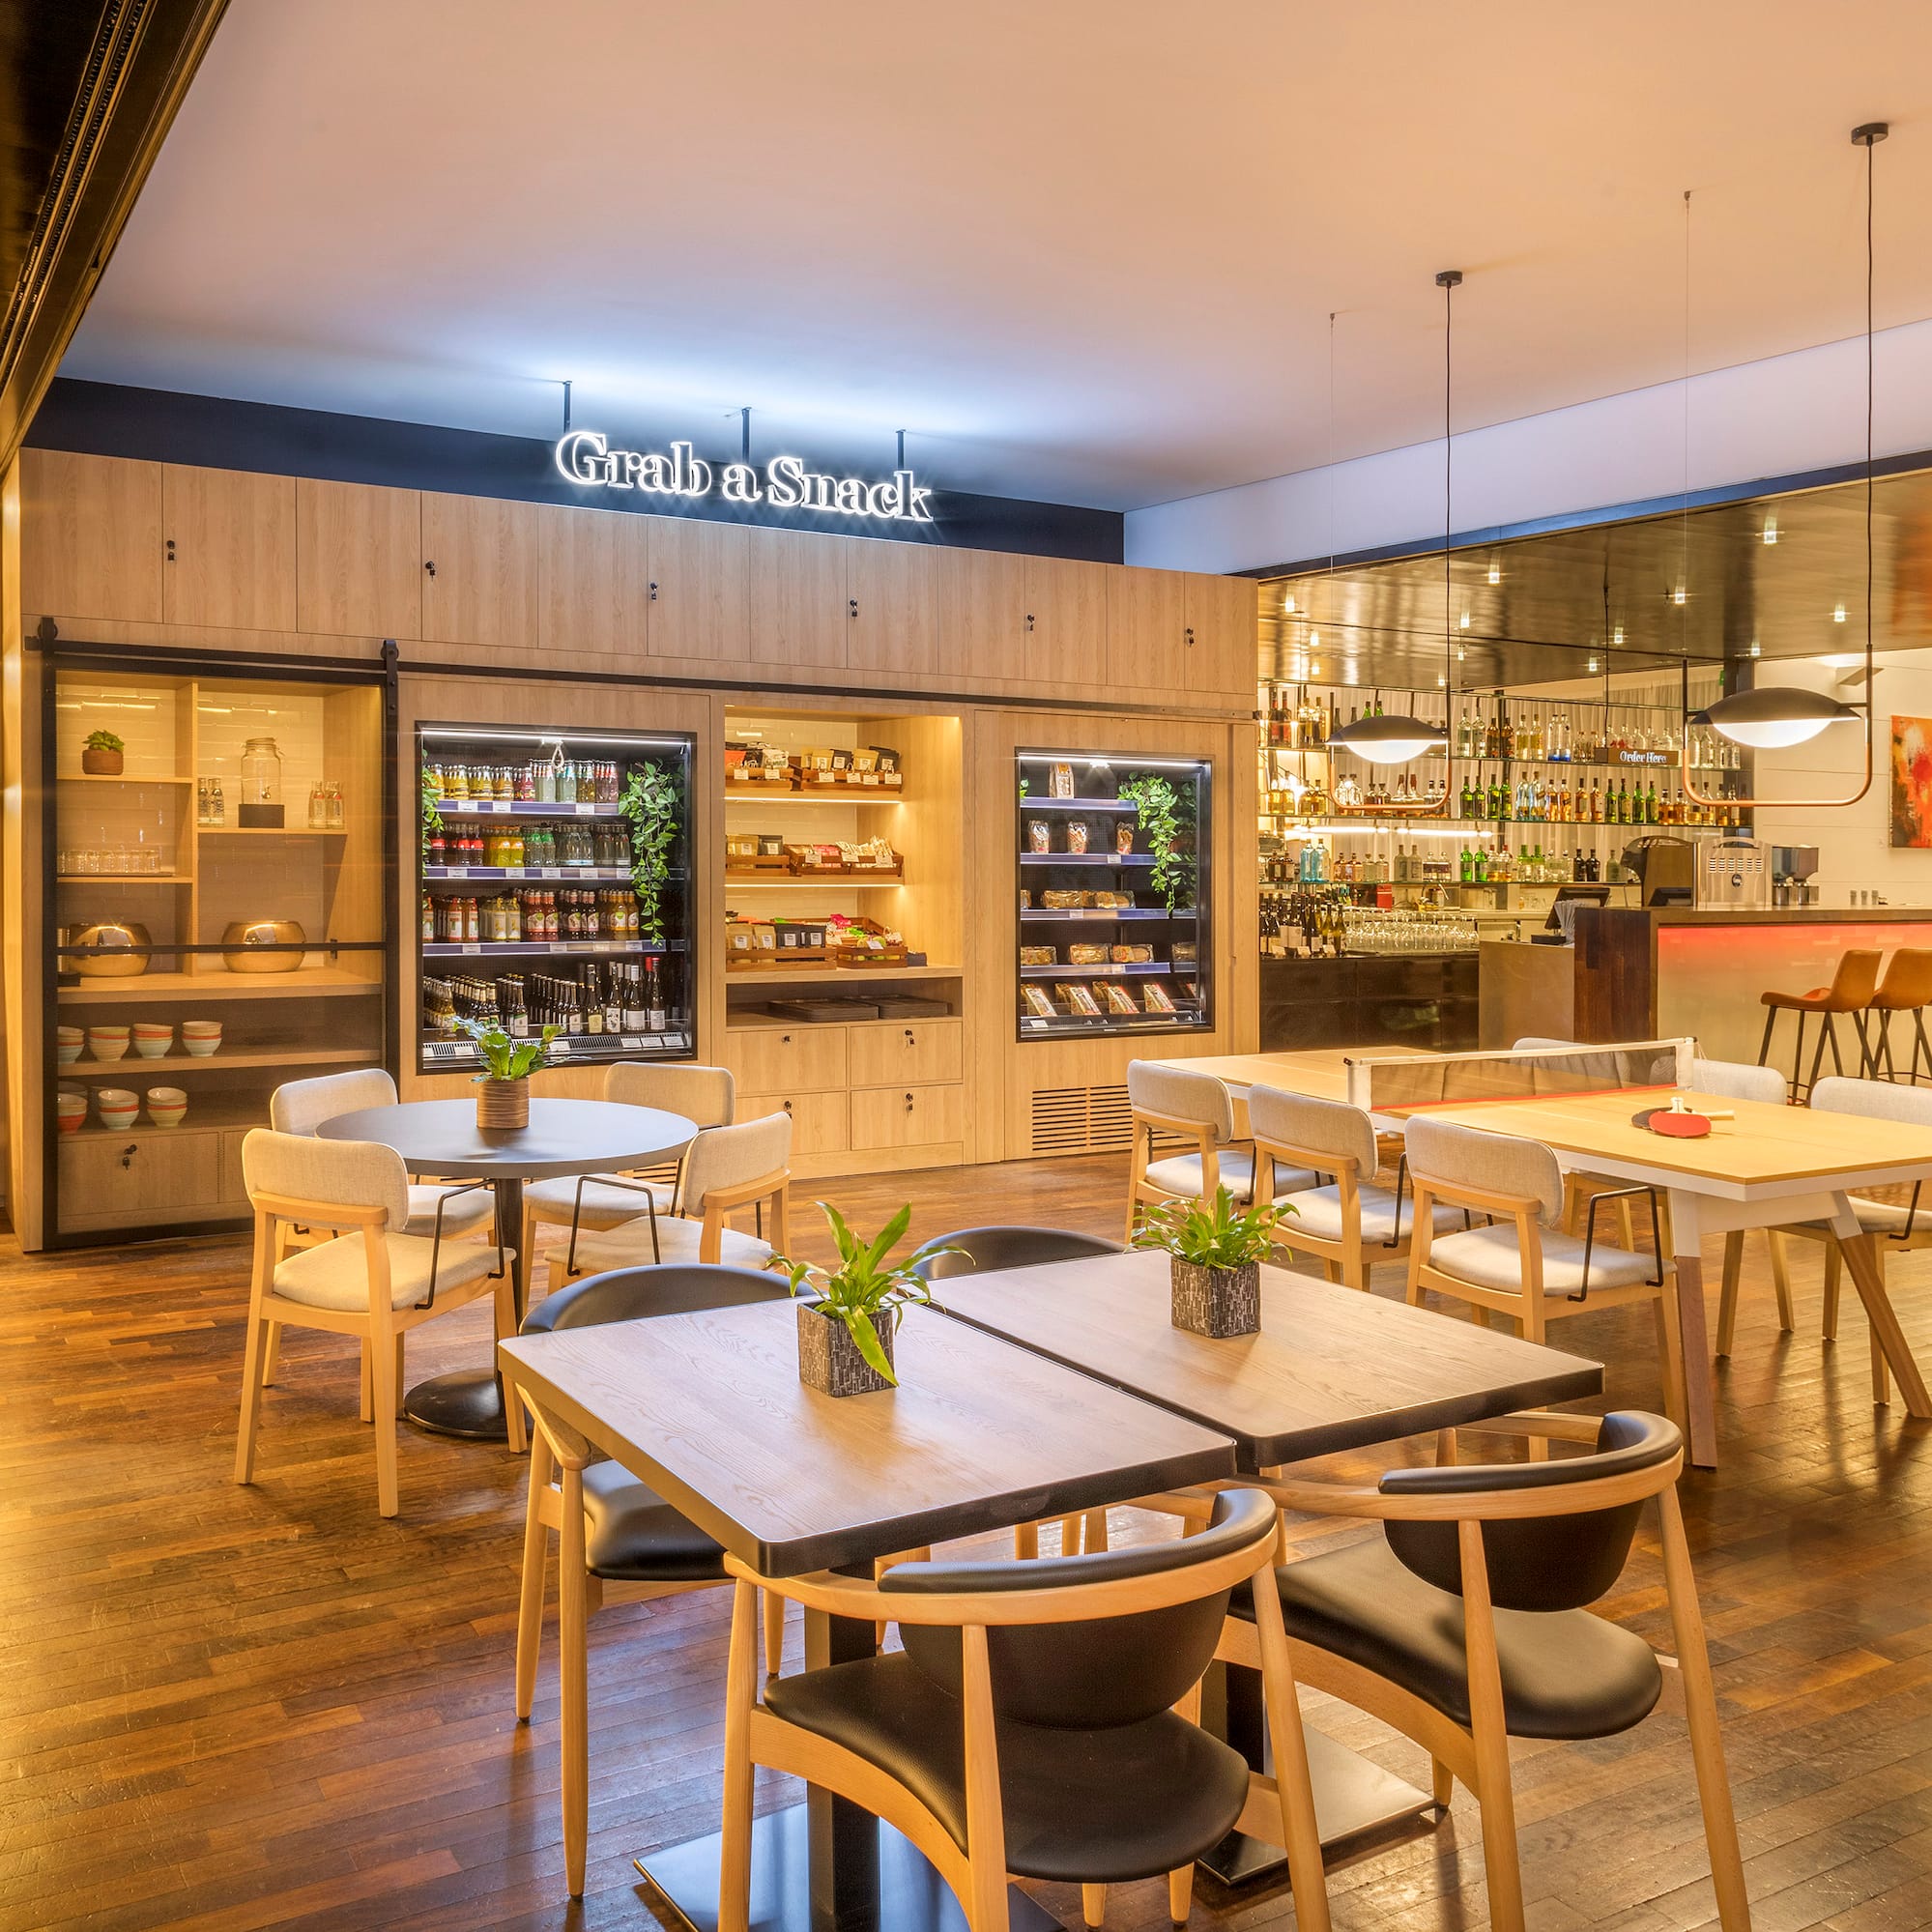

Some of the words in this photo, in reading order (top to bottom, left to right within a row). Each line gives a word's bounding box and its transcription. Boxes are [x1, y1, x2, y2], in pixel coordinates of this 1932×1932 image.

[555, 431, 712, 497] Grab
[721, 463, 762, 503] a
[767, 456, 935, 522] Snack
[1620, 751, 1646, 763] Order
[1647, 752, 1667, 763] Here
